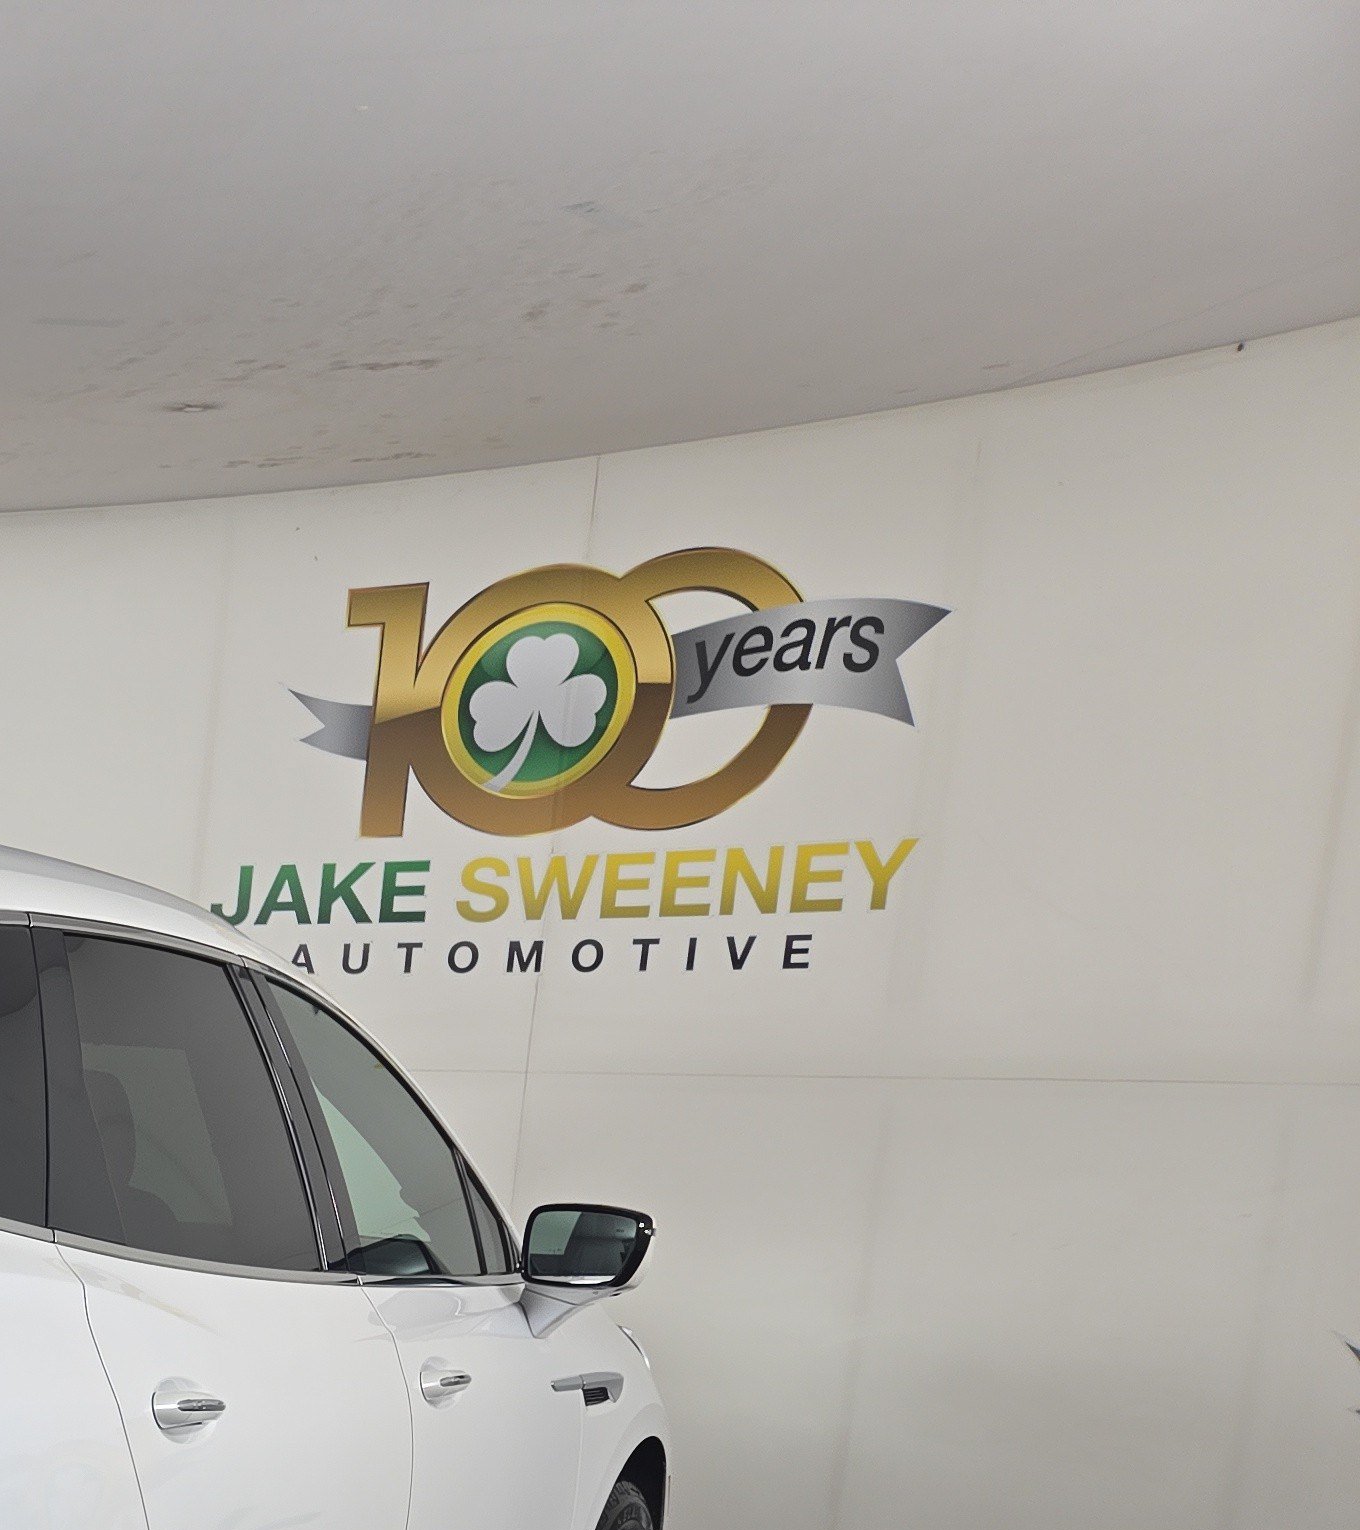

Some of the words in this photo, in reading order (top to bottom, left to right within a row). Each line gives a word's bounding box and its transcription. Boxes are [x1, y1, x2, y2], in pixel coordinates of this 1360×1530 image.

[686, 607, 885, 704] years
[210, 859, 431, 926] JAKE
[455, 838, 921, 922] SWEENEY
[291, 933, 813, 975] AUTOMOTIVE
